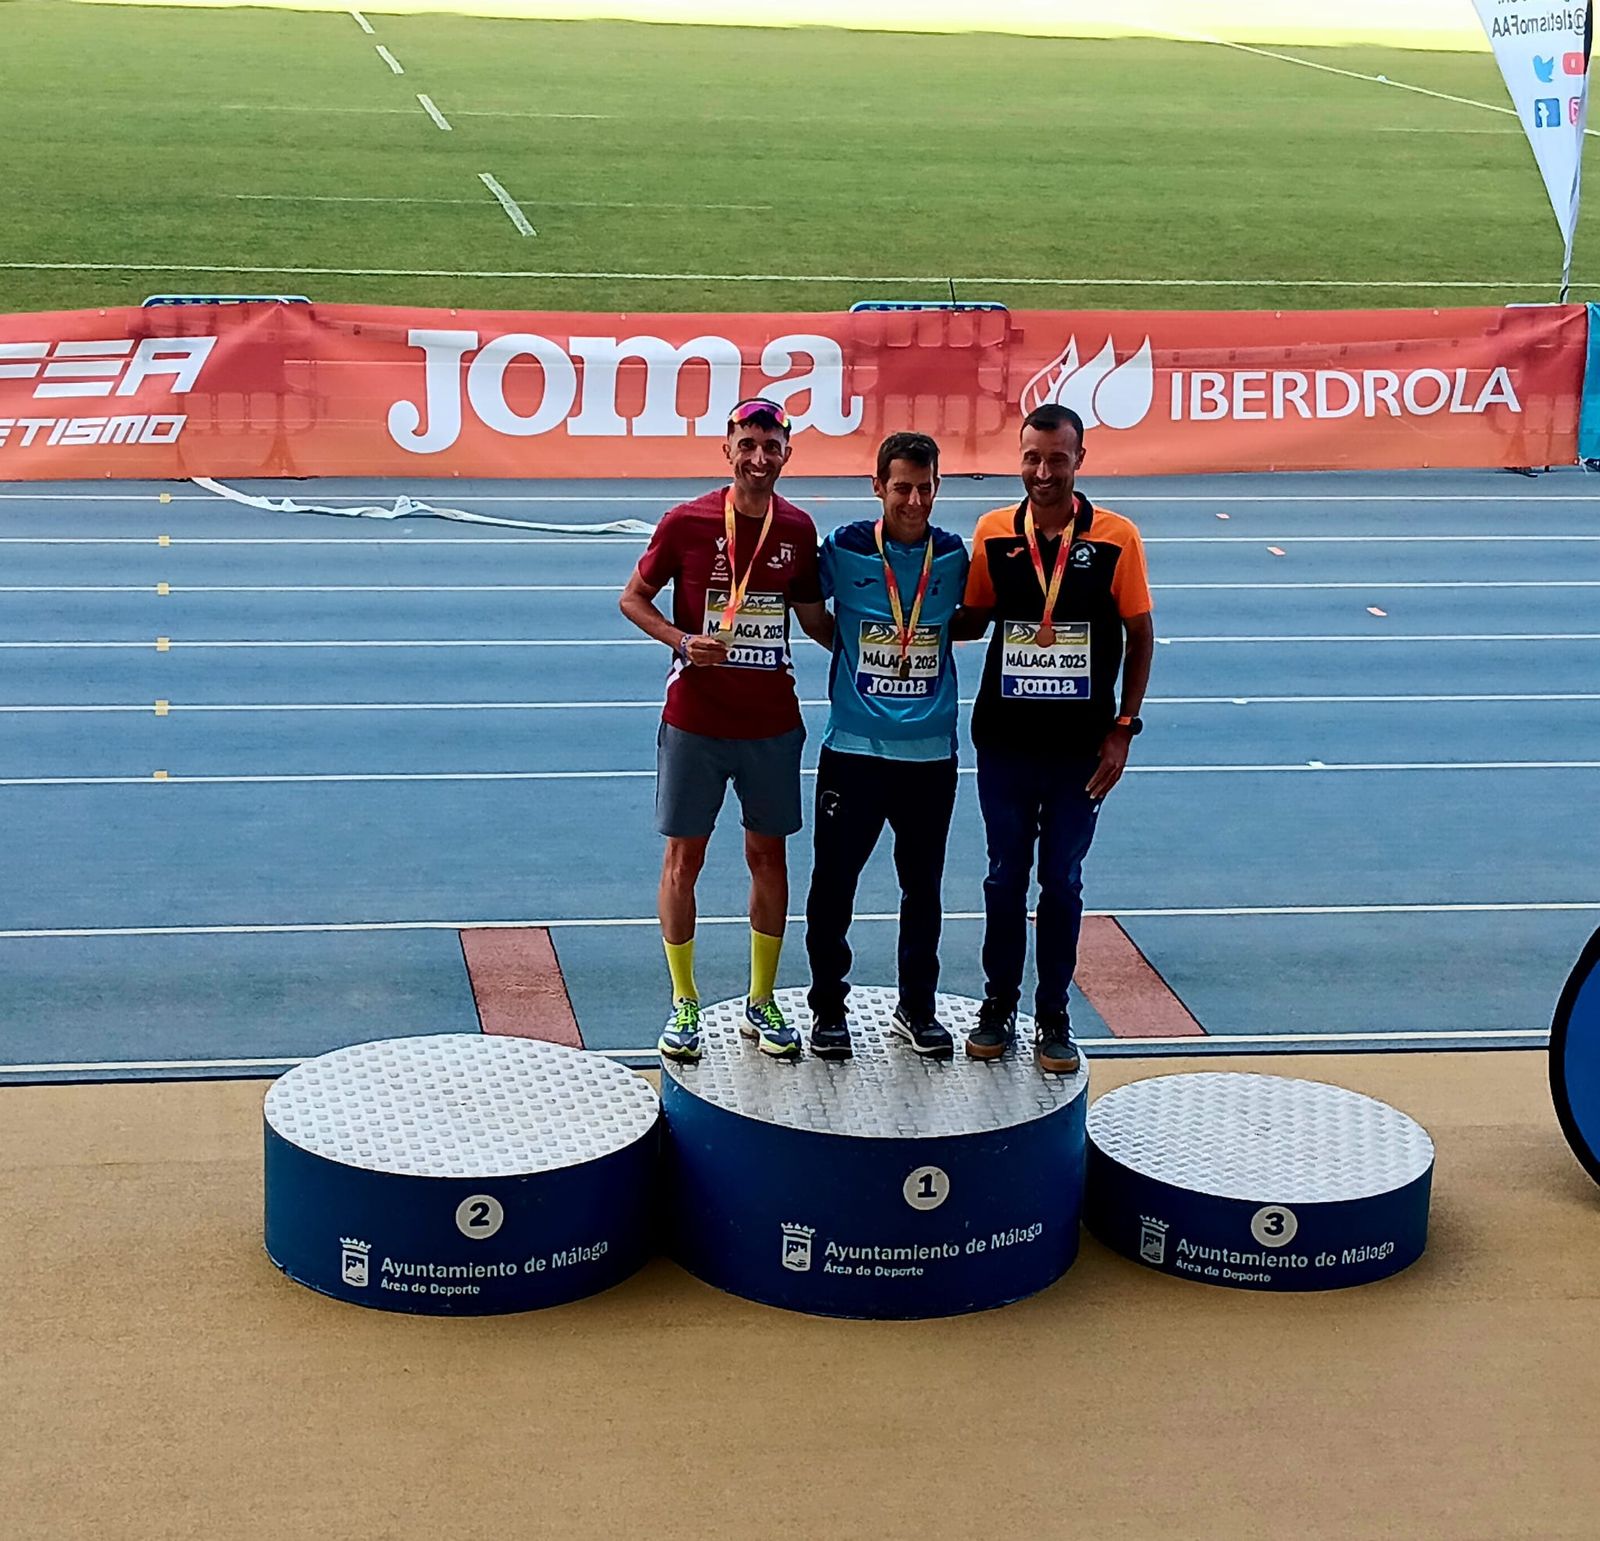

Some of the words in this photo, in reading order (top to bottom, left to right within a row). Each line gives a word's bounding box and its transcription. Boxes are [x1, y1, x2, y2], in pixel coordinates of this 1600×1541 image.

[1170, 367, 1521, 421] IBERDROLA
[707, 619, 761, 639] MAGA
[726, 647, 777, 666] oma
[1005, 650, 1056, 668] MÁLAGA
[1059, 654, 1087, 669] 2025
[917, 1173, 938, 1198] 1
[469, 1201, 490, 1227] 2
[1263, 1211, 1285, 1236] 3
[825, 1241, 960, 1262] Ayuntamiento
[965, 1238, 986, 1255] de
[990, 1221, 1043, 1250] Málaga
[1176, 1238, 1308, 1268] Ayuntamiento
[1315, 1251, 1336, 1267] de
[1341, 1241, 1395, 1265] Málaga
[381, 1257, 518, 1278] Ayuntamiento
[524, 1256, 547, 1274] de
[551, 1241, 608, 1269] Málaga
[823, 1260, 851, 1275] Área
[856, 1264, 871, 1276] de
[875, 1265, 924, 1278] Deporte
[1176, 1256, 1201, 1273] Área
[1204, 1265, 1220, 1277] de
[1223, 1268, 1272, 1282] Deporte
[381, 1276, 409, 1292] Área
[411, 1283, 427, 1294] de
[430, 1283, 481, 1297] Deporte
